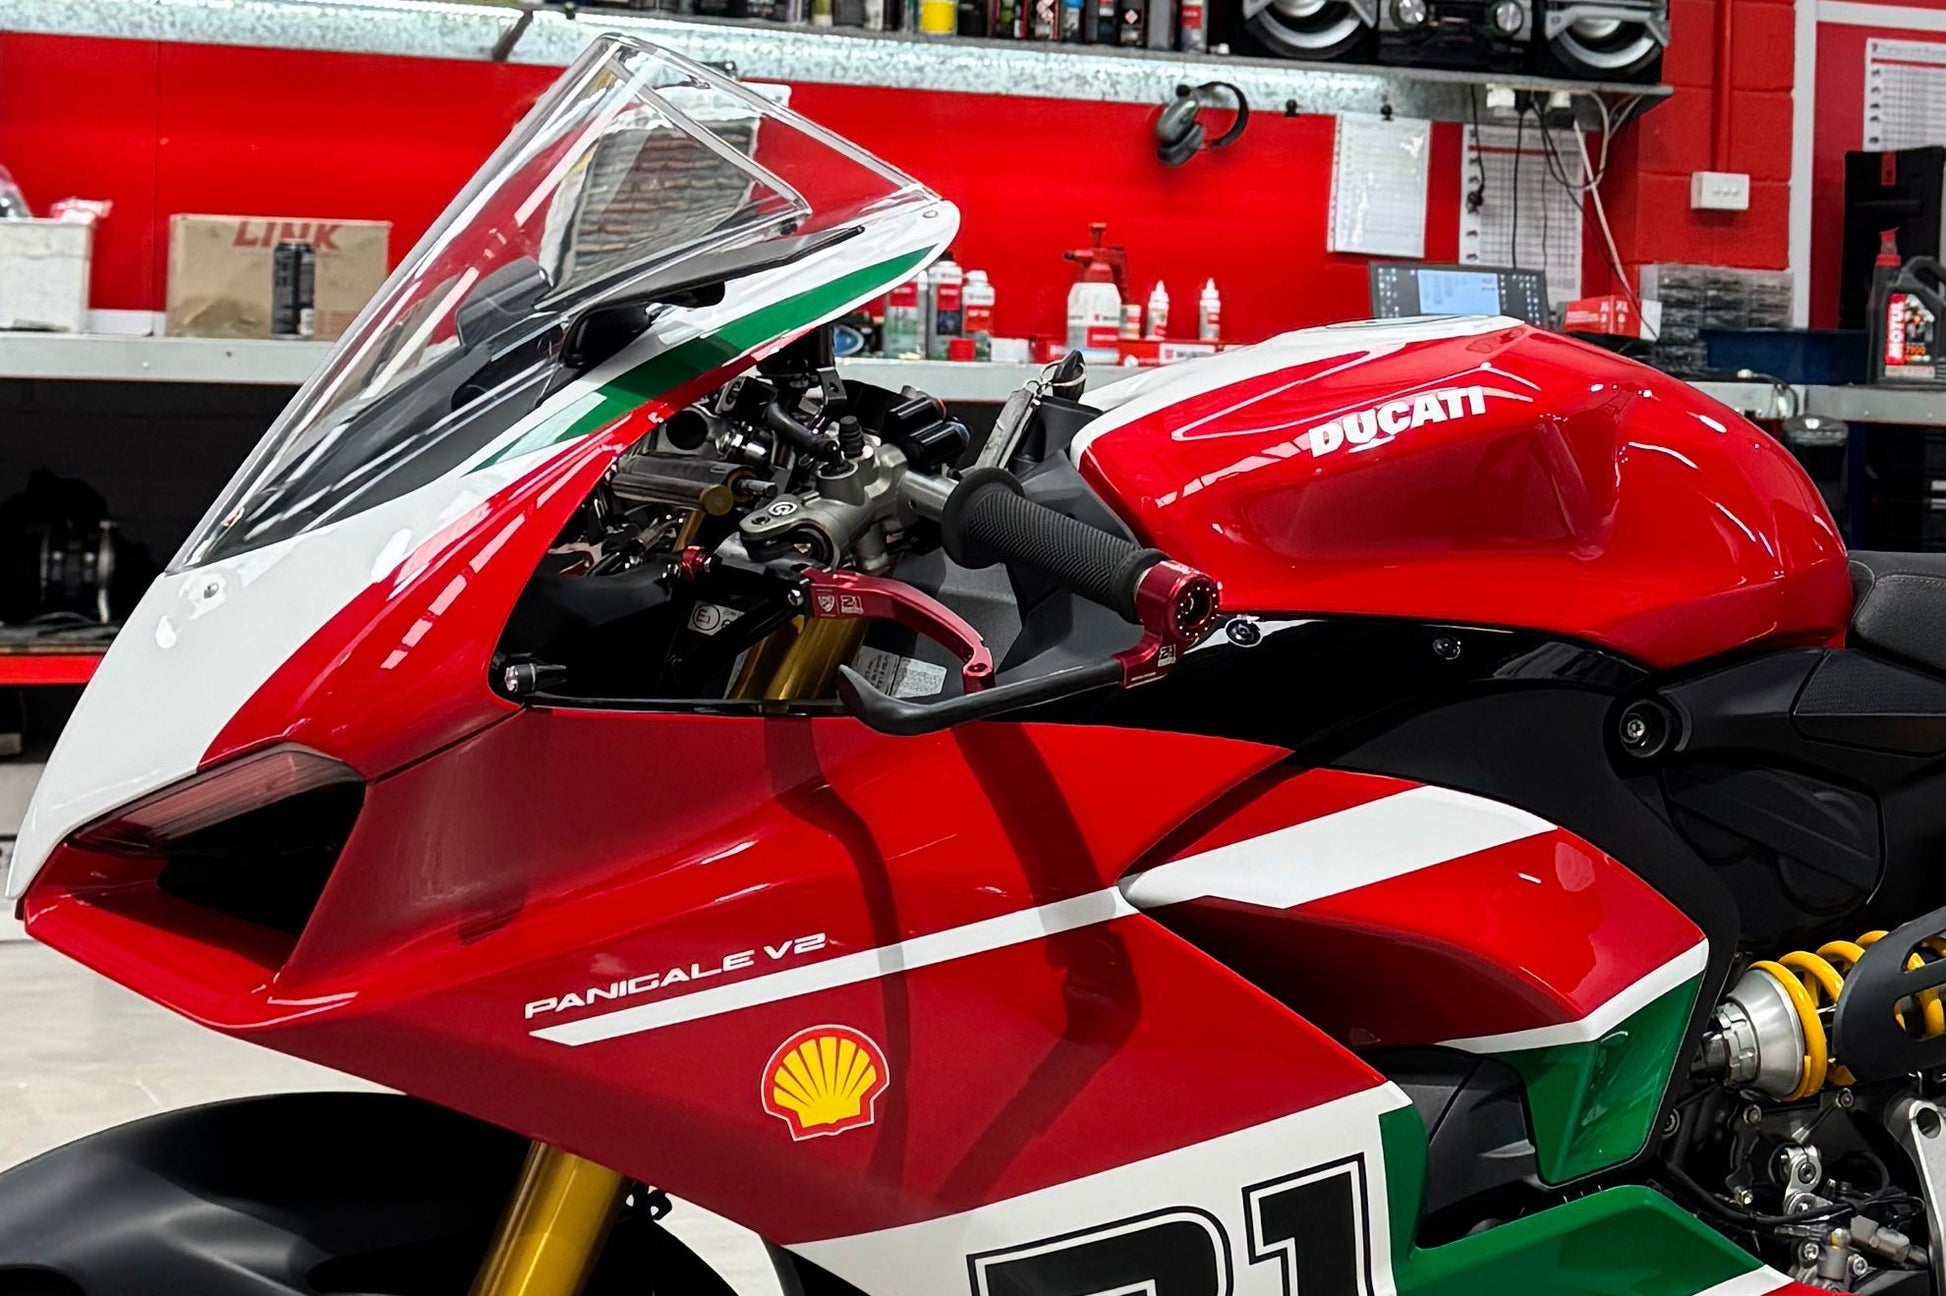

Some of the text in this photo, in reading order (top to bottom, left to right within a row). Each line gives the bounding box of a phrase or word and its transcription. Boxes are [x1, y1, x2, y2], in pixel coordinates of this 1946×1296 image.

[232, 220, 343, 250] LINK
[1887, 301, 1905, 359] MOTUL
[1308, 385, 1486, 457] DUCATI
[524, 932, 827, 1019] PANIGALE V2
